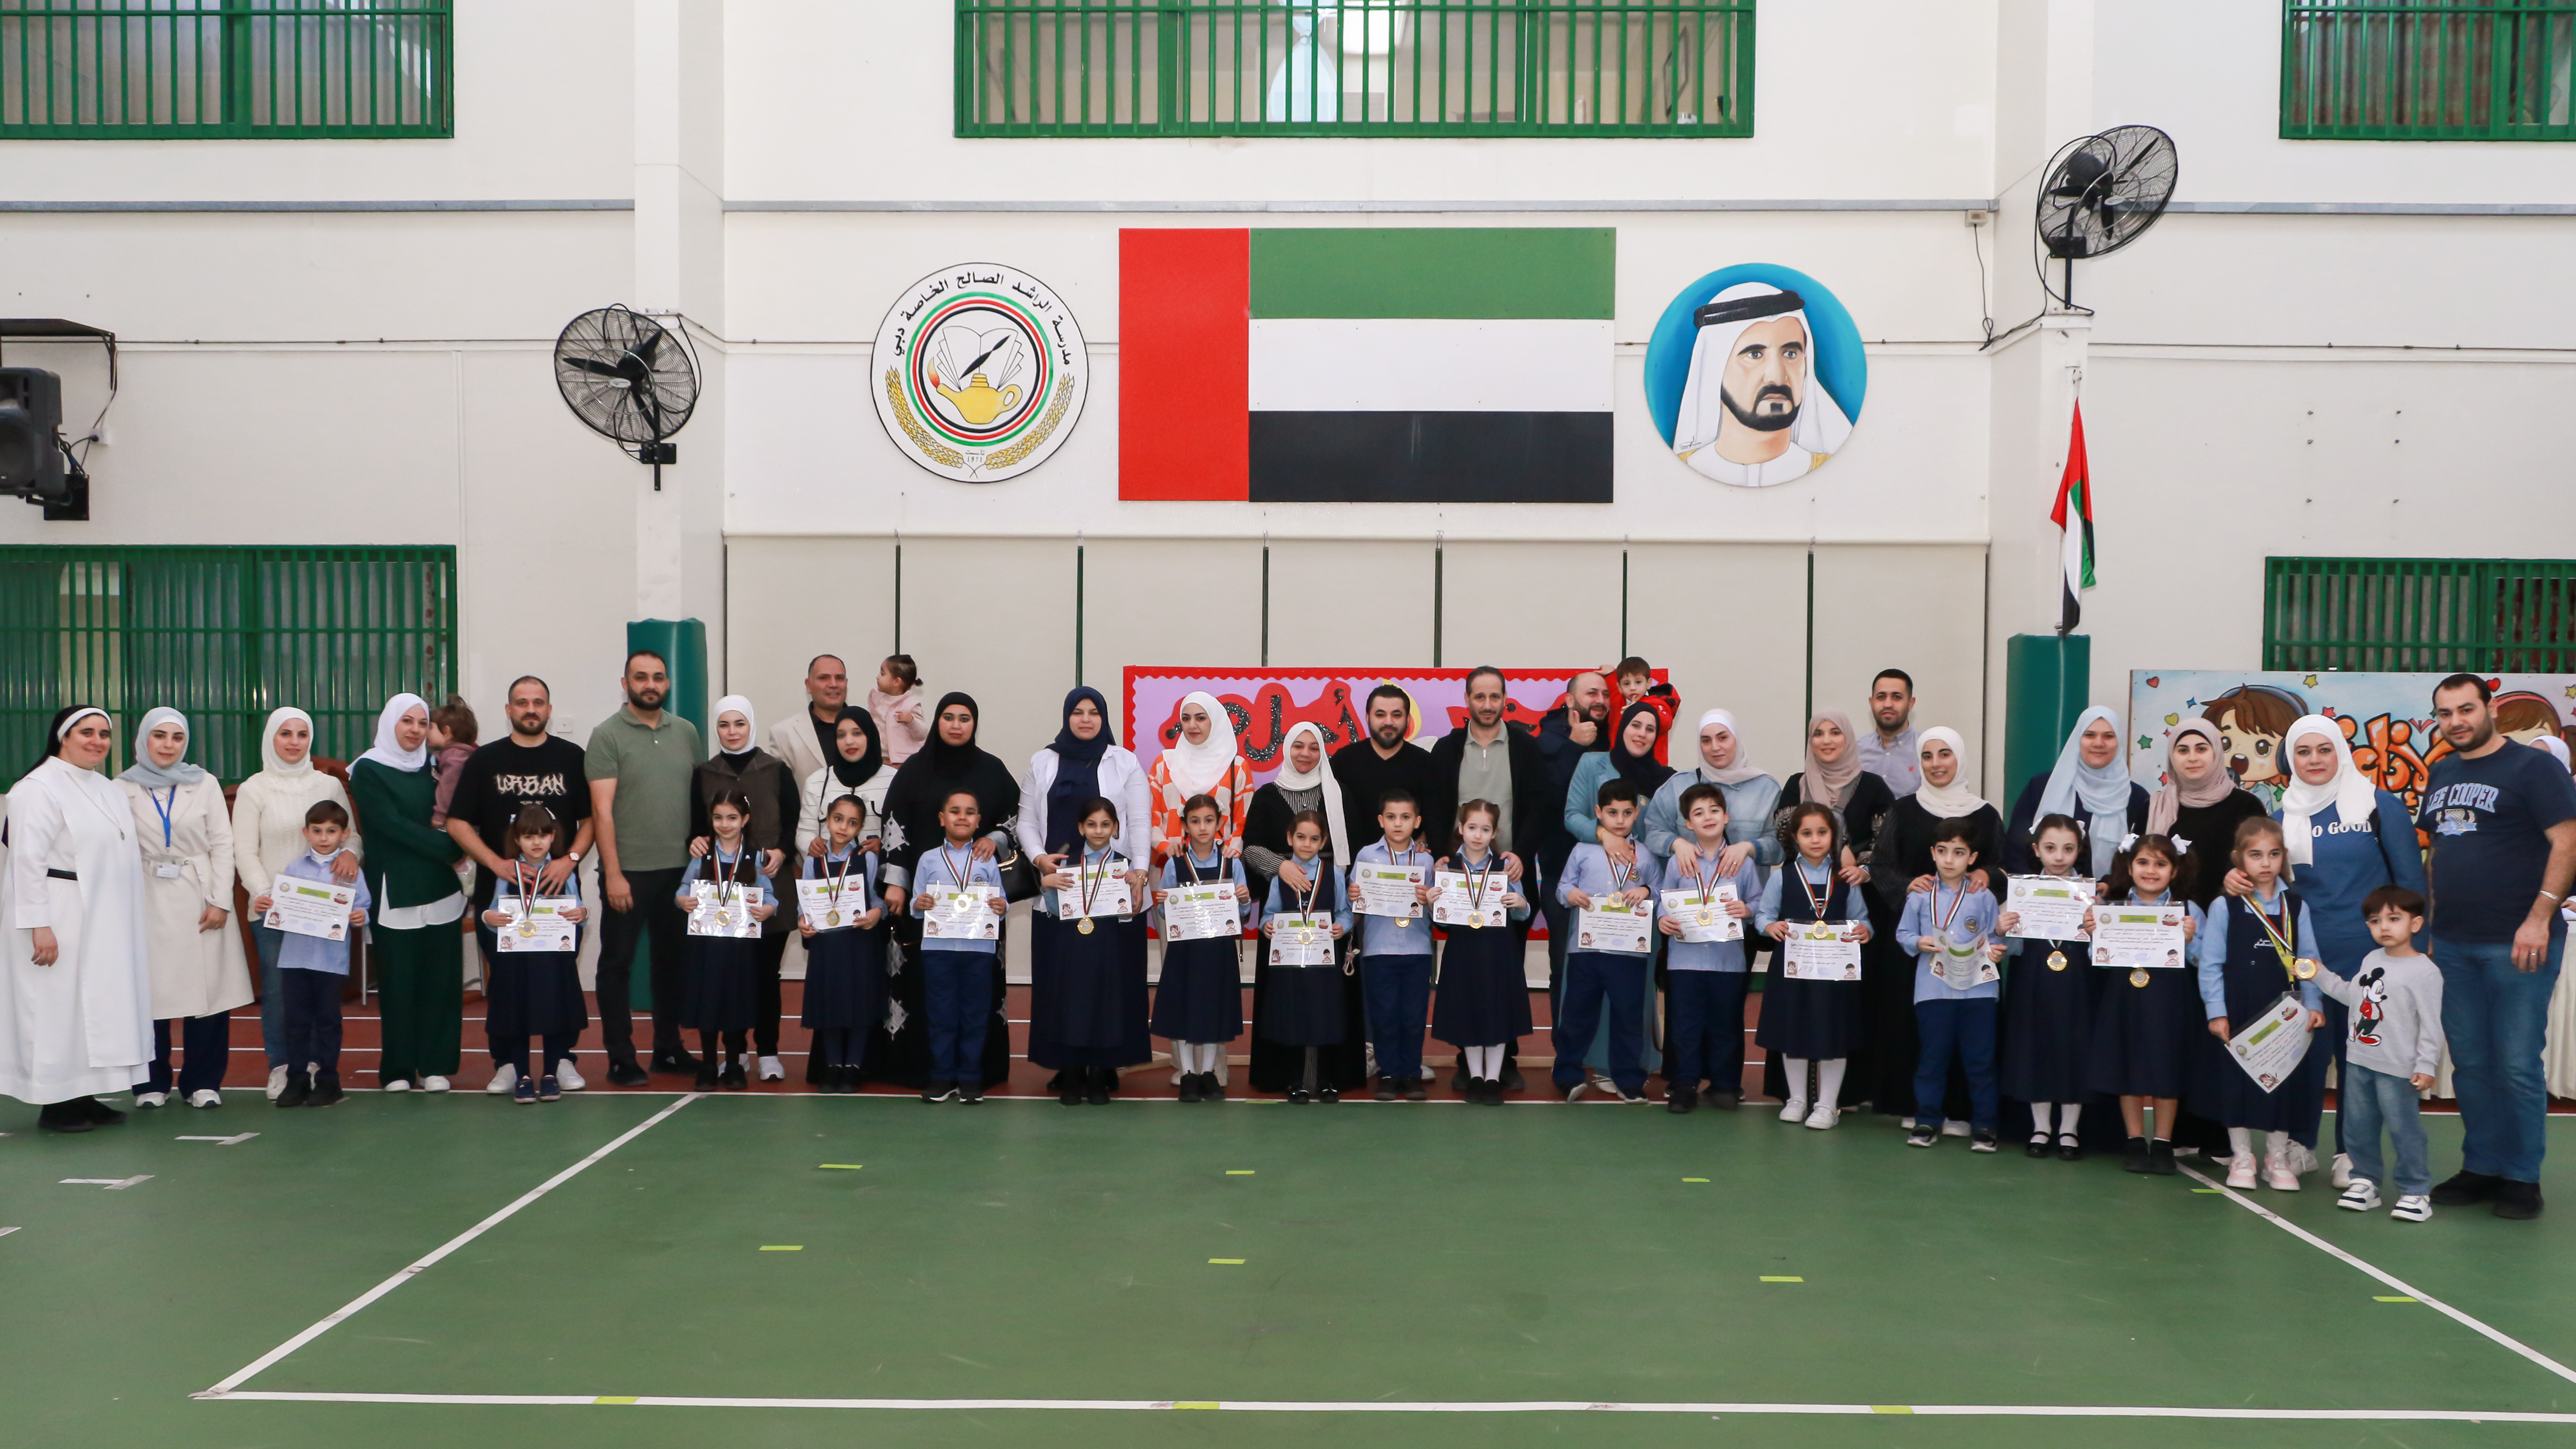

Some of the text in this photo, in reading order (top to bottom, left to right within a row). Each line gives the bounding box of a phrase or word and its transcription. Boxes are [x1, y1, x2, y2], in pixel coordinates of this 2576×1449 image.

[893, 271, 1072, 365] مدرسة الراشد الصالح الخاصة دبي
[2426, 783, 2499, 815] LEE COOPER
